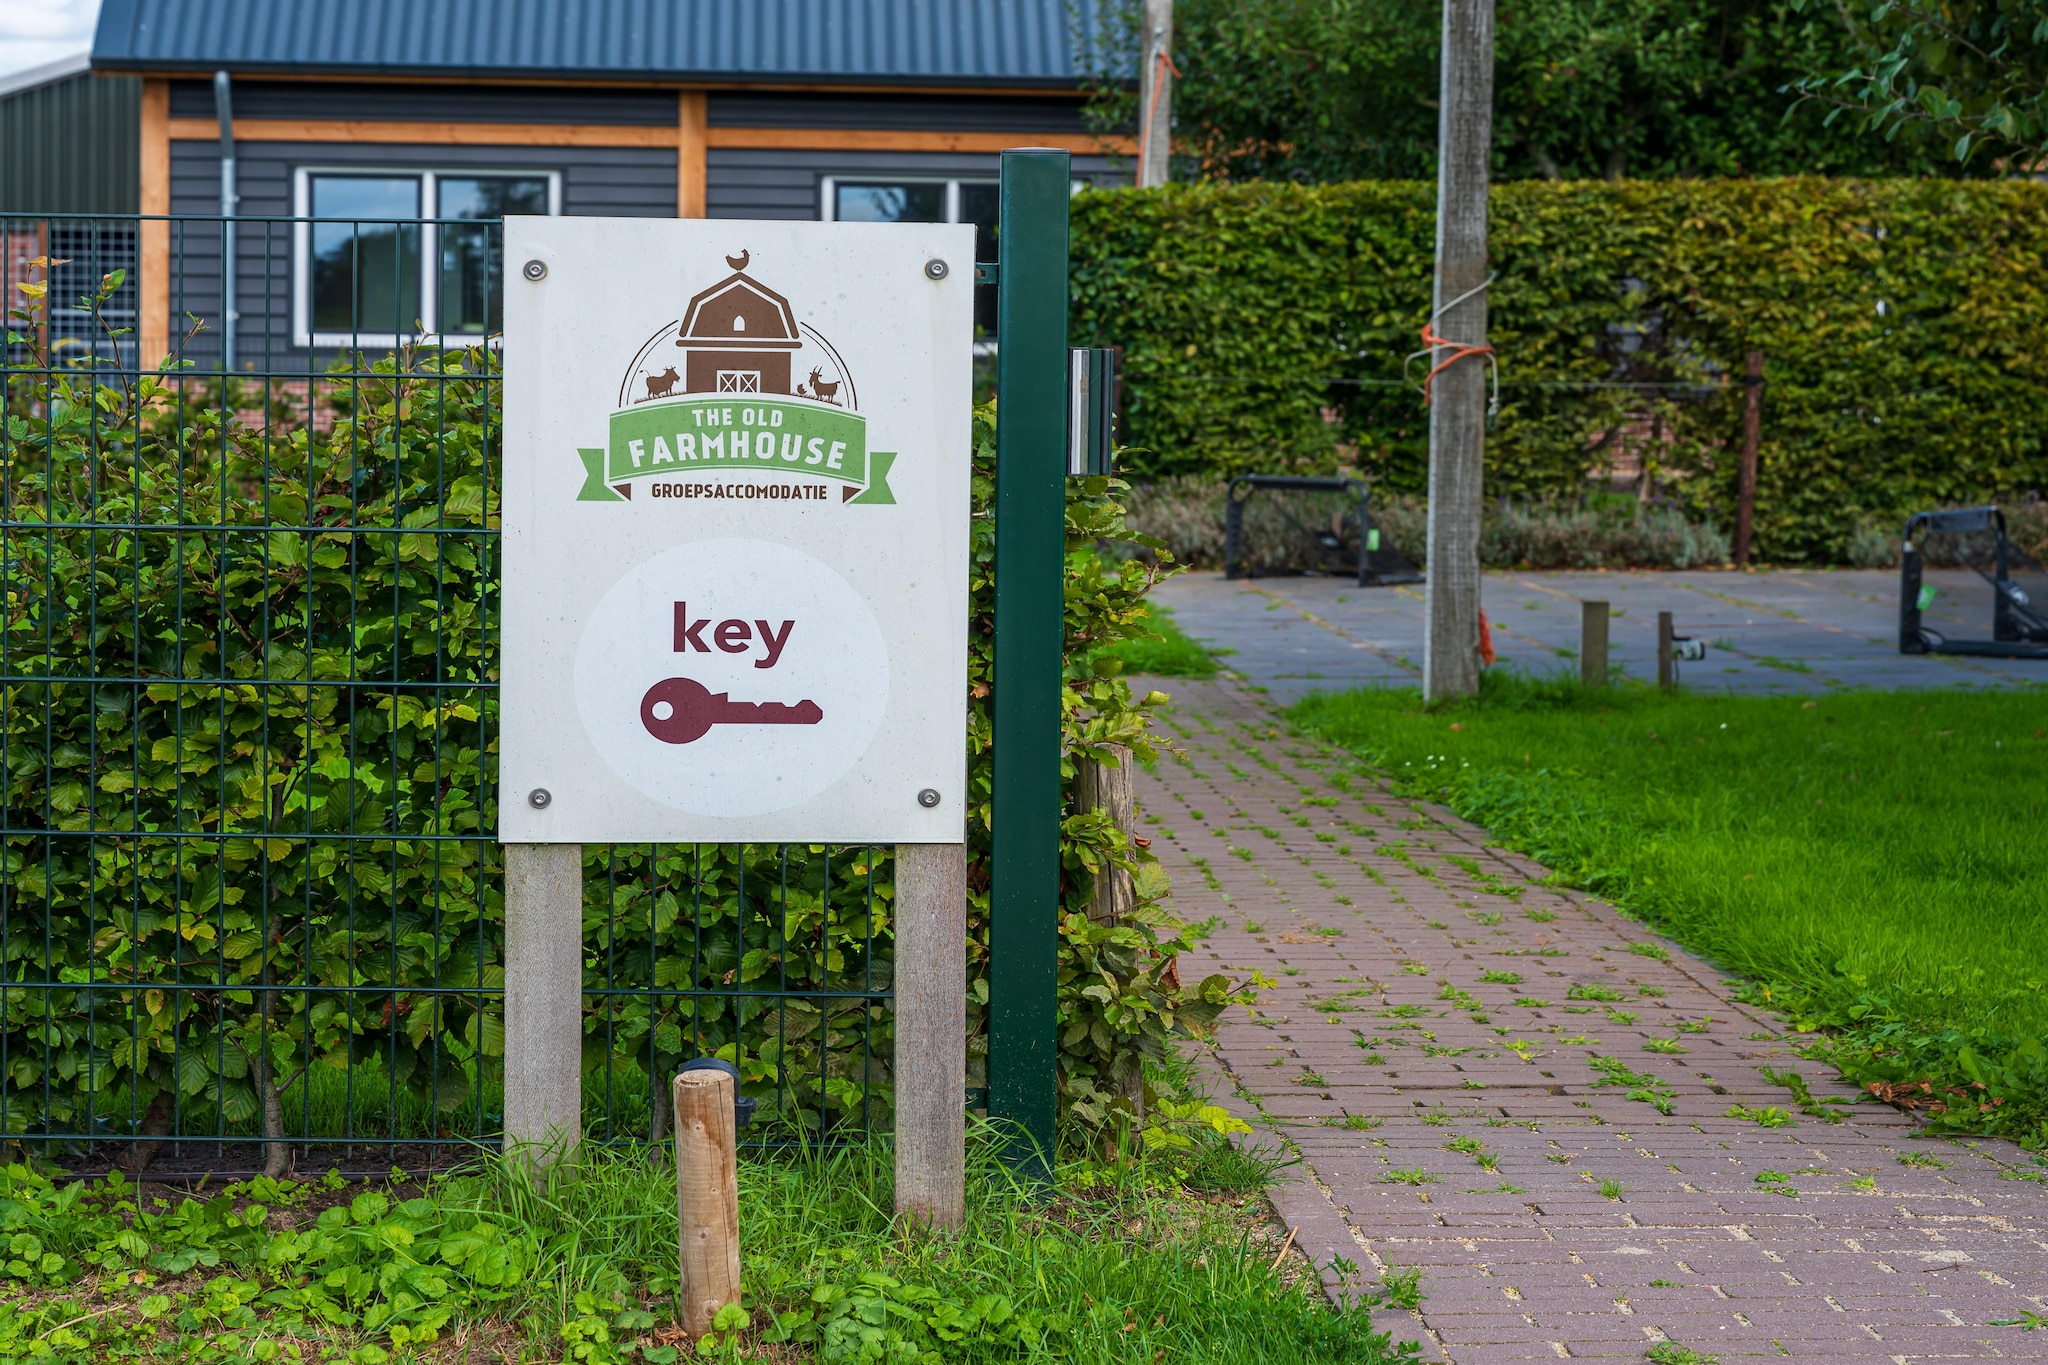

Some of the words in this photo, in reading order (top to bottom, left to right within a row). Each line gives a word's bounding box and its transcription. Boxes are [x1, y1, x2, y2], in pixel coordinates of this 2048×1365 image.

[691, 408, 733, 427] THE
[742, 408, 783, 427] OLD
[628, 430, 847, 470] FARMHOUSE
[651, 483, 827, 500] GROEPSACCOMODATIE
[673, 601, 795, 669] key
